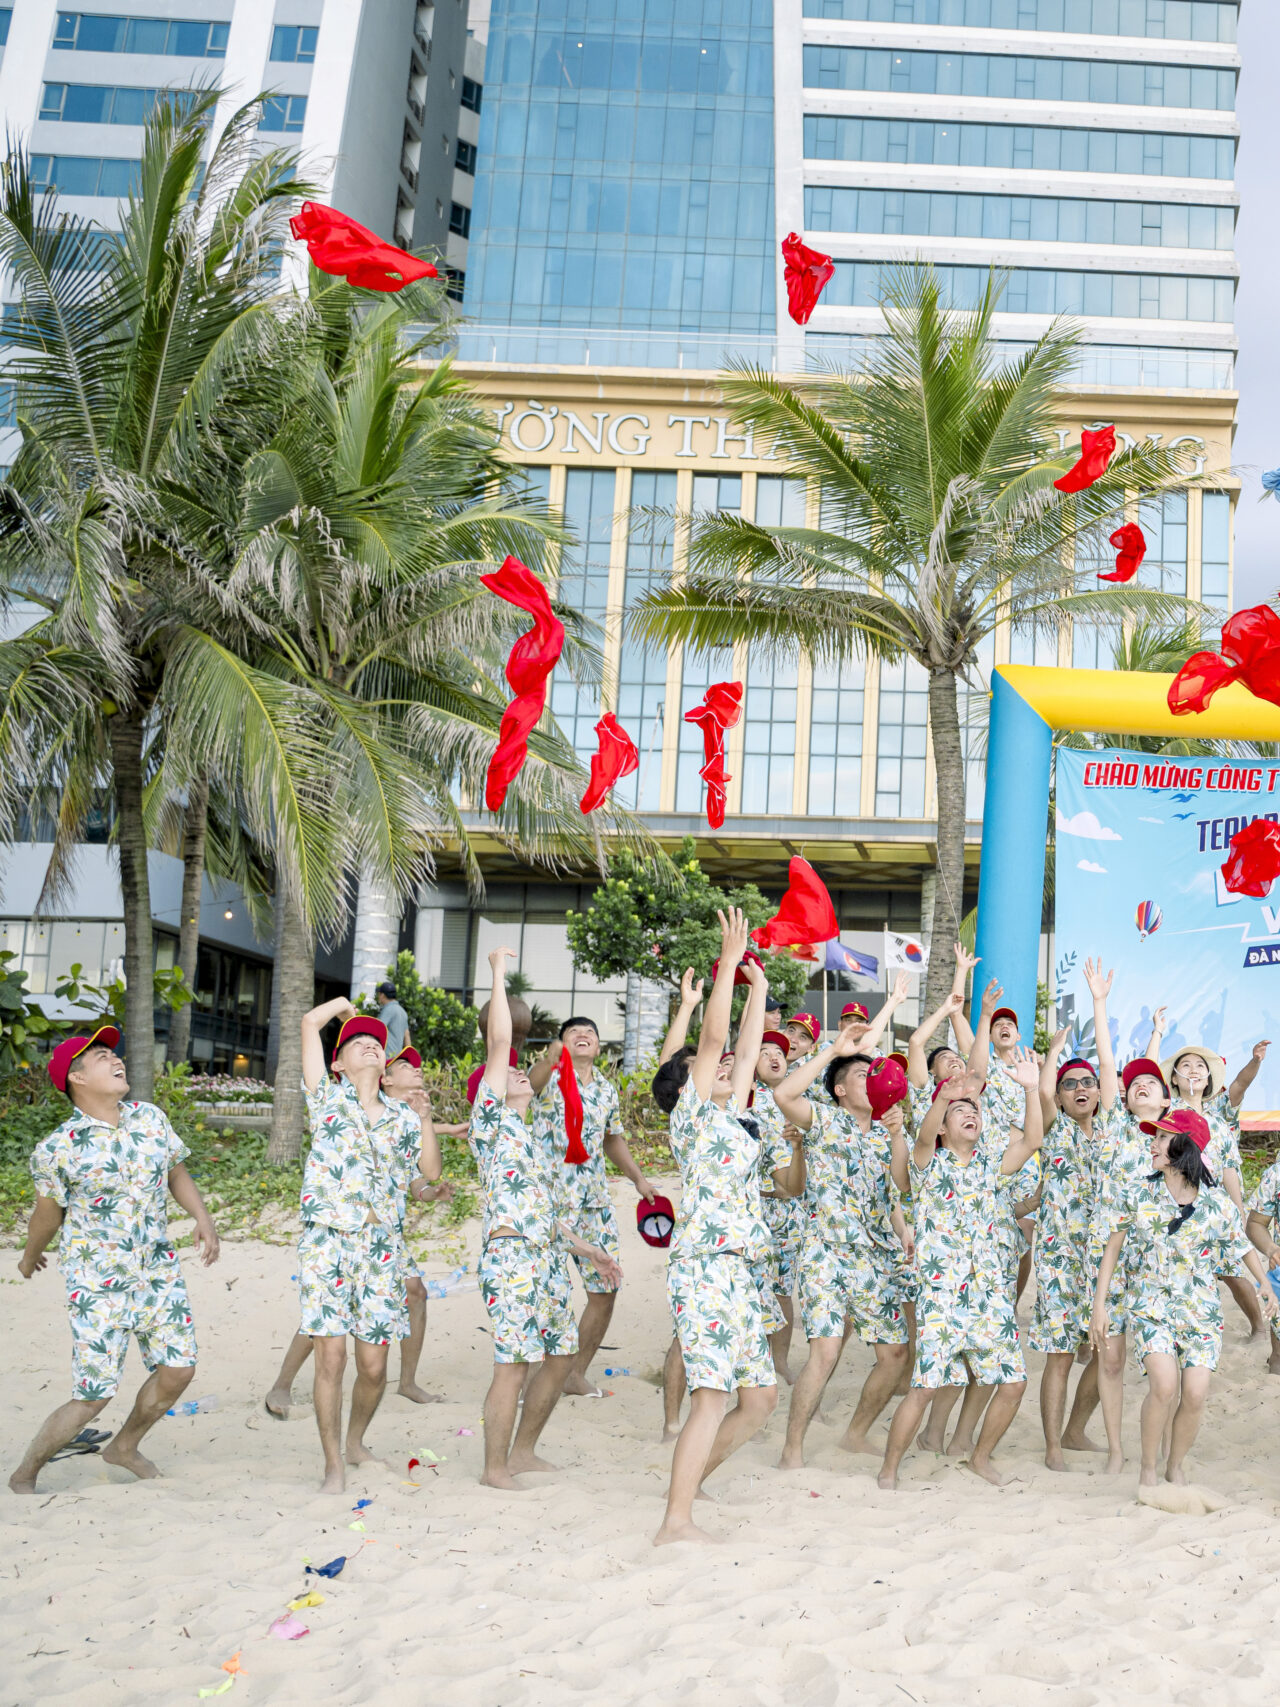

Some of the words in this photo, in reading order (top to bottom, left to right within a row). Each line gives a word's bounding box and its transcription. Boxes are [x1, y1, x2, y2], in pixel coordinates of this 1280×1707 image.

[1083, 757, 1139, 788] CHÀO
[1141, 760, 1202, 789] MỪNG
[1205, 764, 1262, 791] CÔNG
[1249, 949, 1269, 964] ĐÀ
